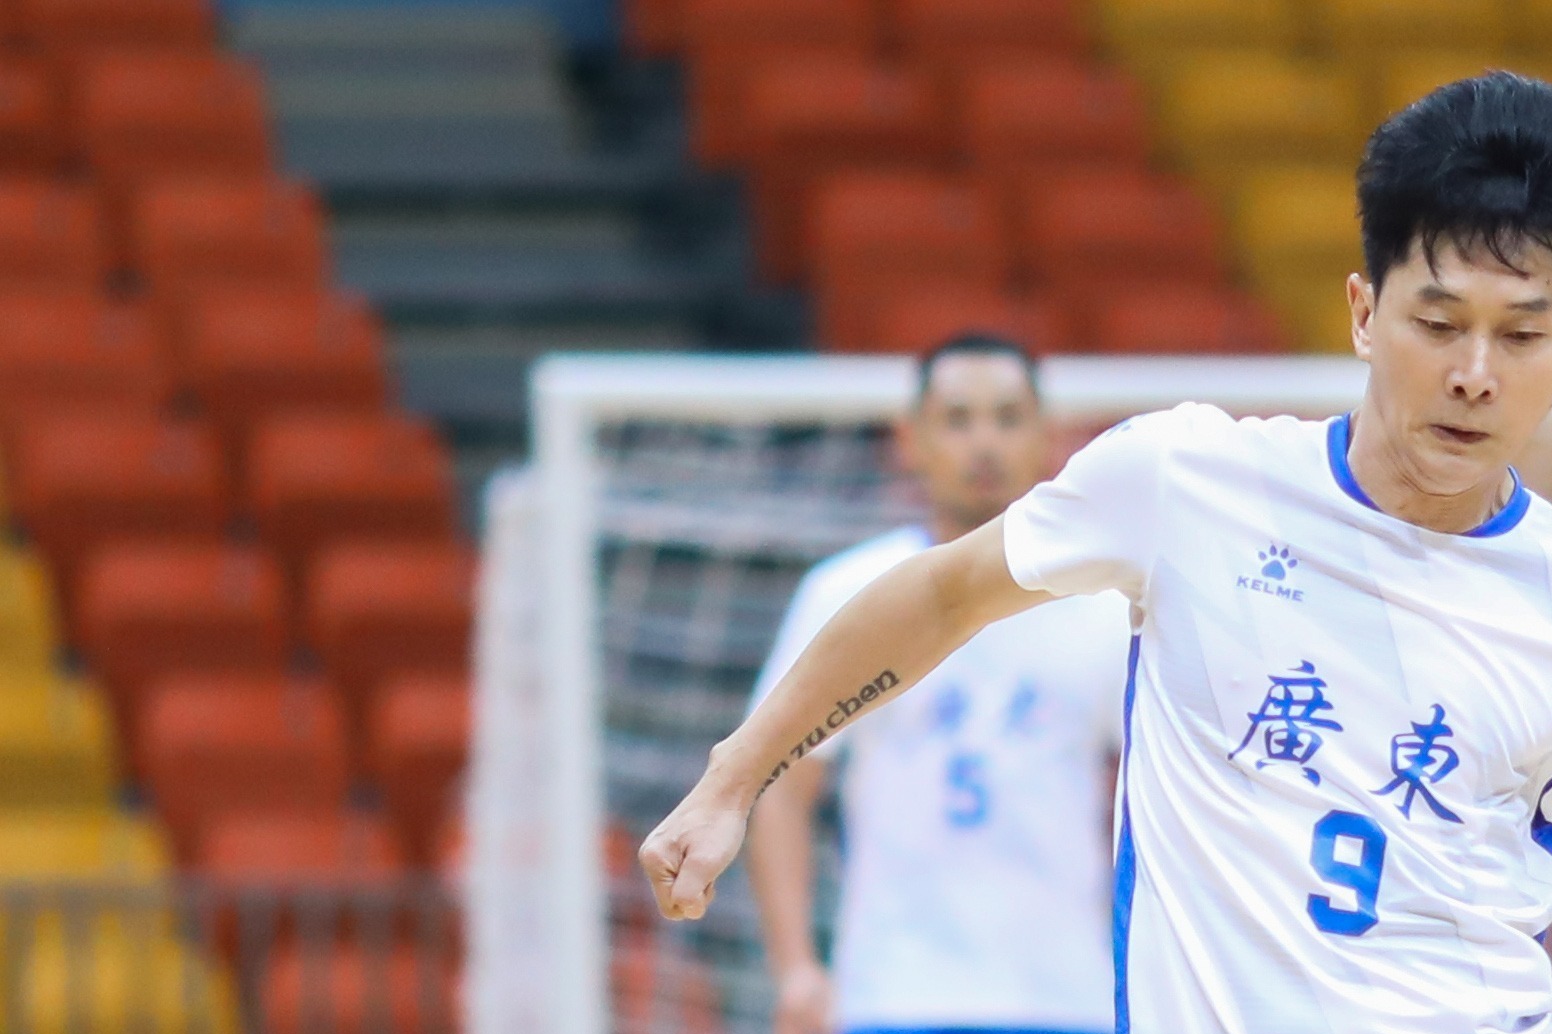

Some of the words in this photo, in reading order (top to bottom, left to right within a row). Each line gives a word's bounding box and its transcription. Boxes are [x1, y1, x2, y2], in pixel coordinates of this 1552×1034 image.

[1237, 576, 1303, 602] KELME
[946, 752, 992, 827] 5
[1228, 660, 1464, 824] 廣東
[1307, 809, 1387, 936] 9
